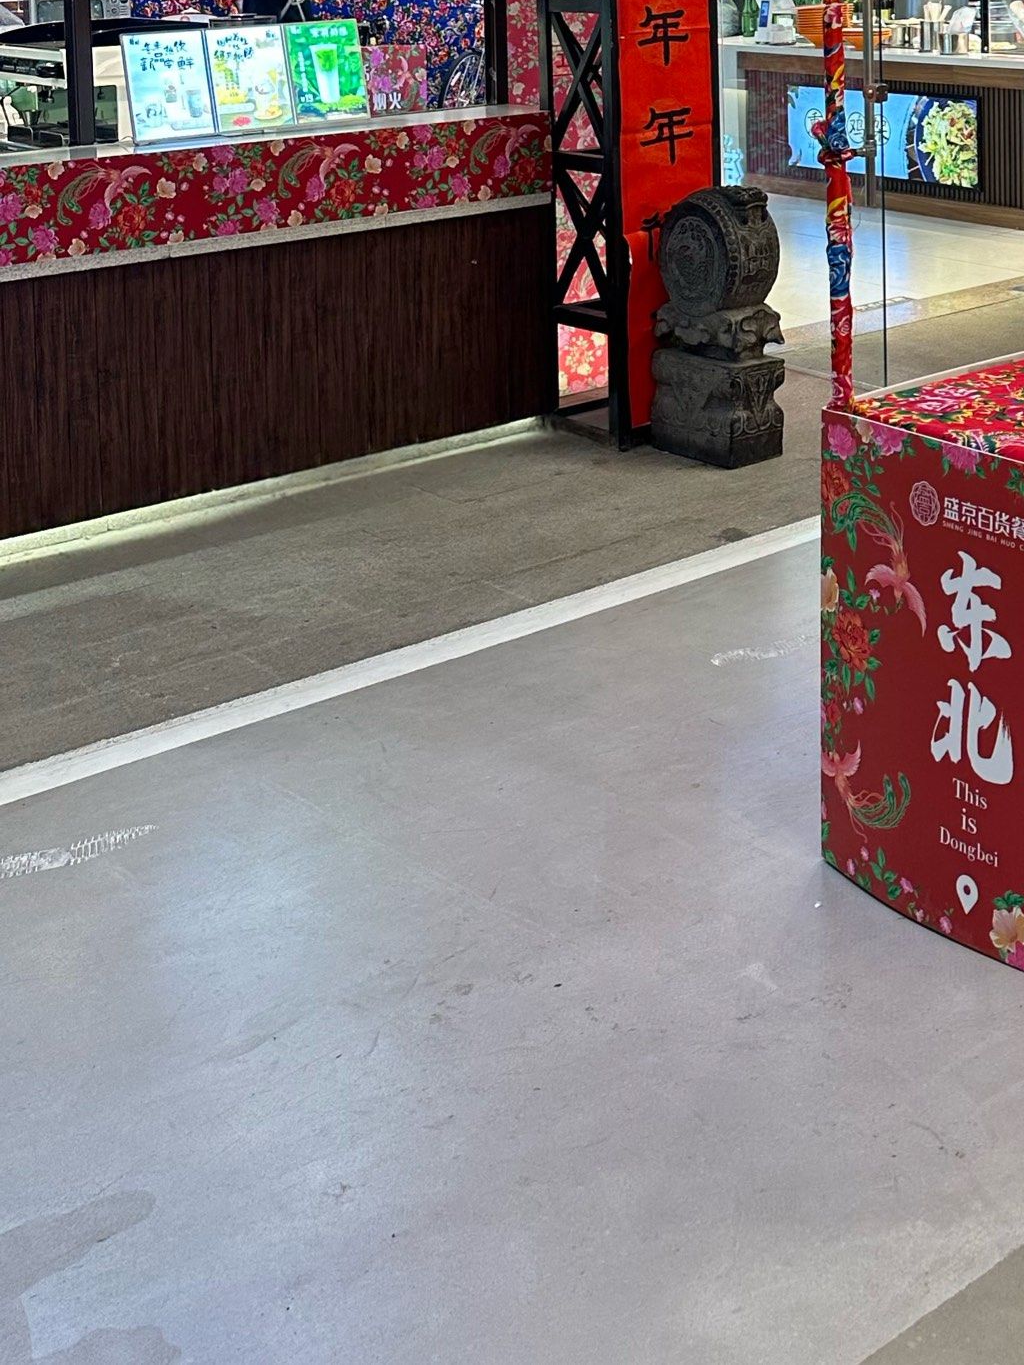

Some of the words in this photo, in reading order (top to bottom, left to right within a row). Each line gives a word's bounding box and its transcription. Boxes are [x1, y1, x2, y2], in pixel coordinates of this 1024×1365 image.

[942, 520, 964, 533] SHENG
[967, 528, 982, 539] JING
[986, 534, 997, 543] BAI
[1001, 539, 1016, 549] HUO
[930, 550, 1014, 785] 东北
[952, 777, 988, 811] This
[960, 808, 977, 835] is
[939, 826, 1000, 868] Dongbei
